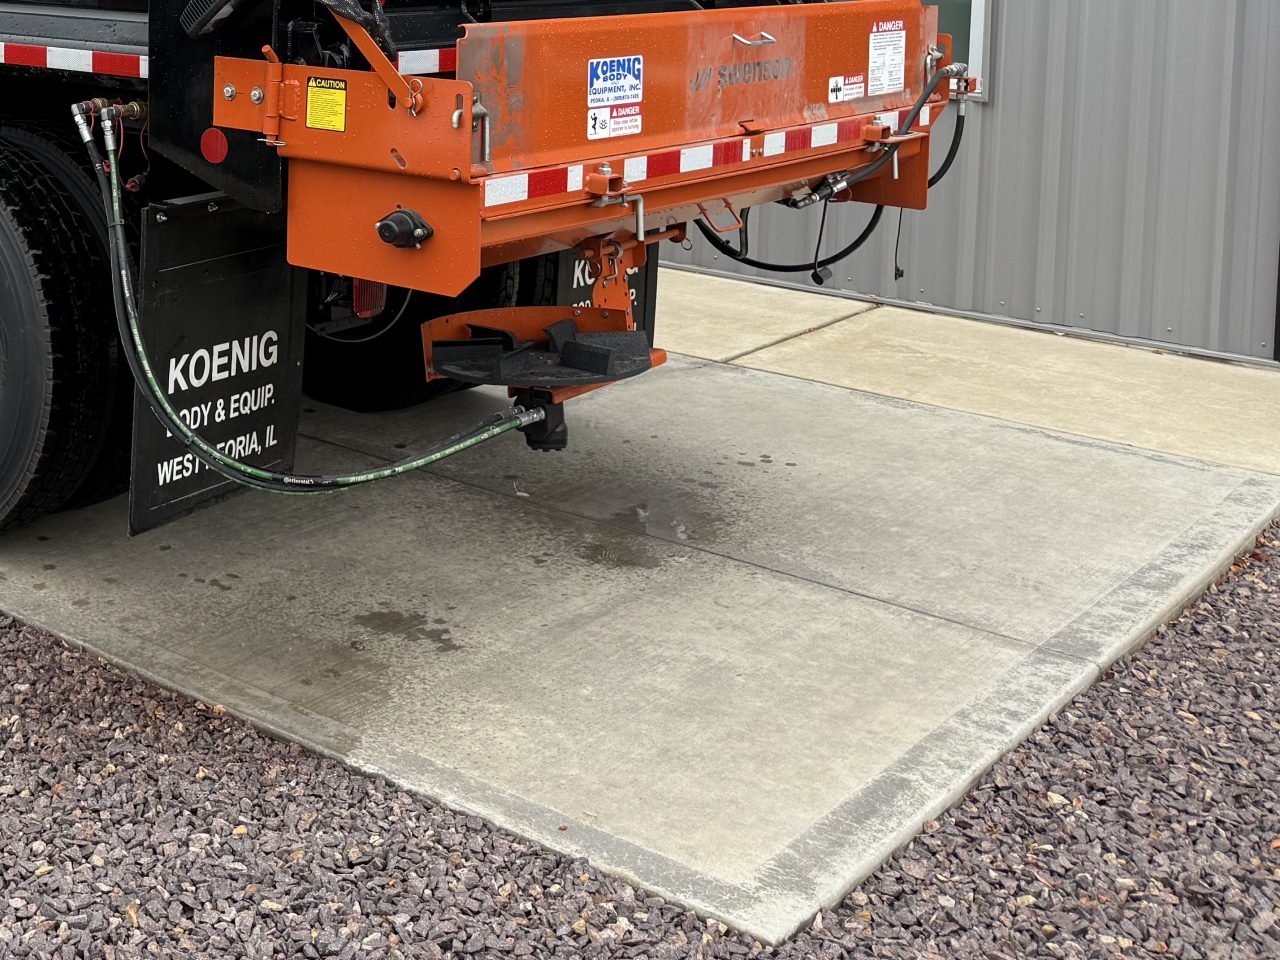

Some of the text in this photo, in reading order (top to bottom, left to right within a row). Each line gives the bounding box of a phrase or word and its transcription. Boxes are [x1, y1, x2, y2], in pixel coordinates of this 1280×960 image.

[878, 20, 904, 32] DANGER
[589, 57, 641, 88] KOENIG
[602, 72, 628, 82] BODY
[718, 58, 792, 87] swenson
[316, 79, 345, 89] CAUTION
[848, 75, 864, 84] DANGER
[589, 83, 641, 96] EQUIPMENT, INC.
[617, 106, 640, 116] DANGER
[168, 330, 278, 395] KOENIG
[166, 401, 212, 438] ODY
[214, 398, 226, 423] &
[229, 383, 275, 419] EQUIP.
[205, 430, 262, 470] ORIA,
[265, 424, 278, 448] IL
